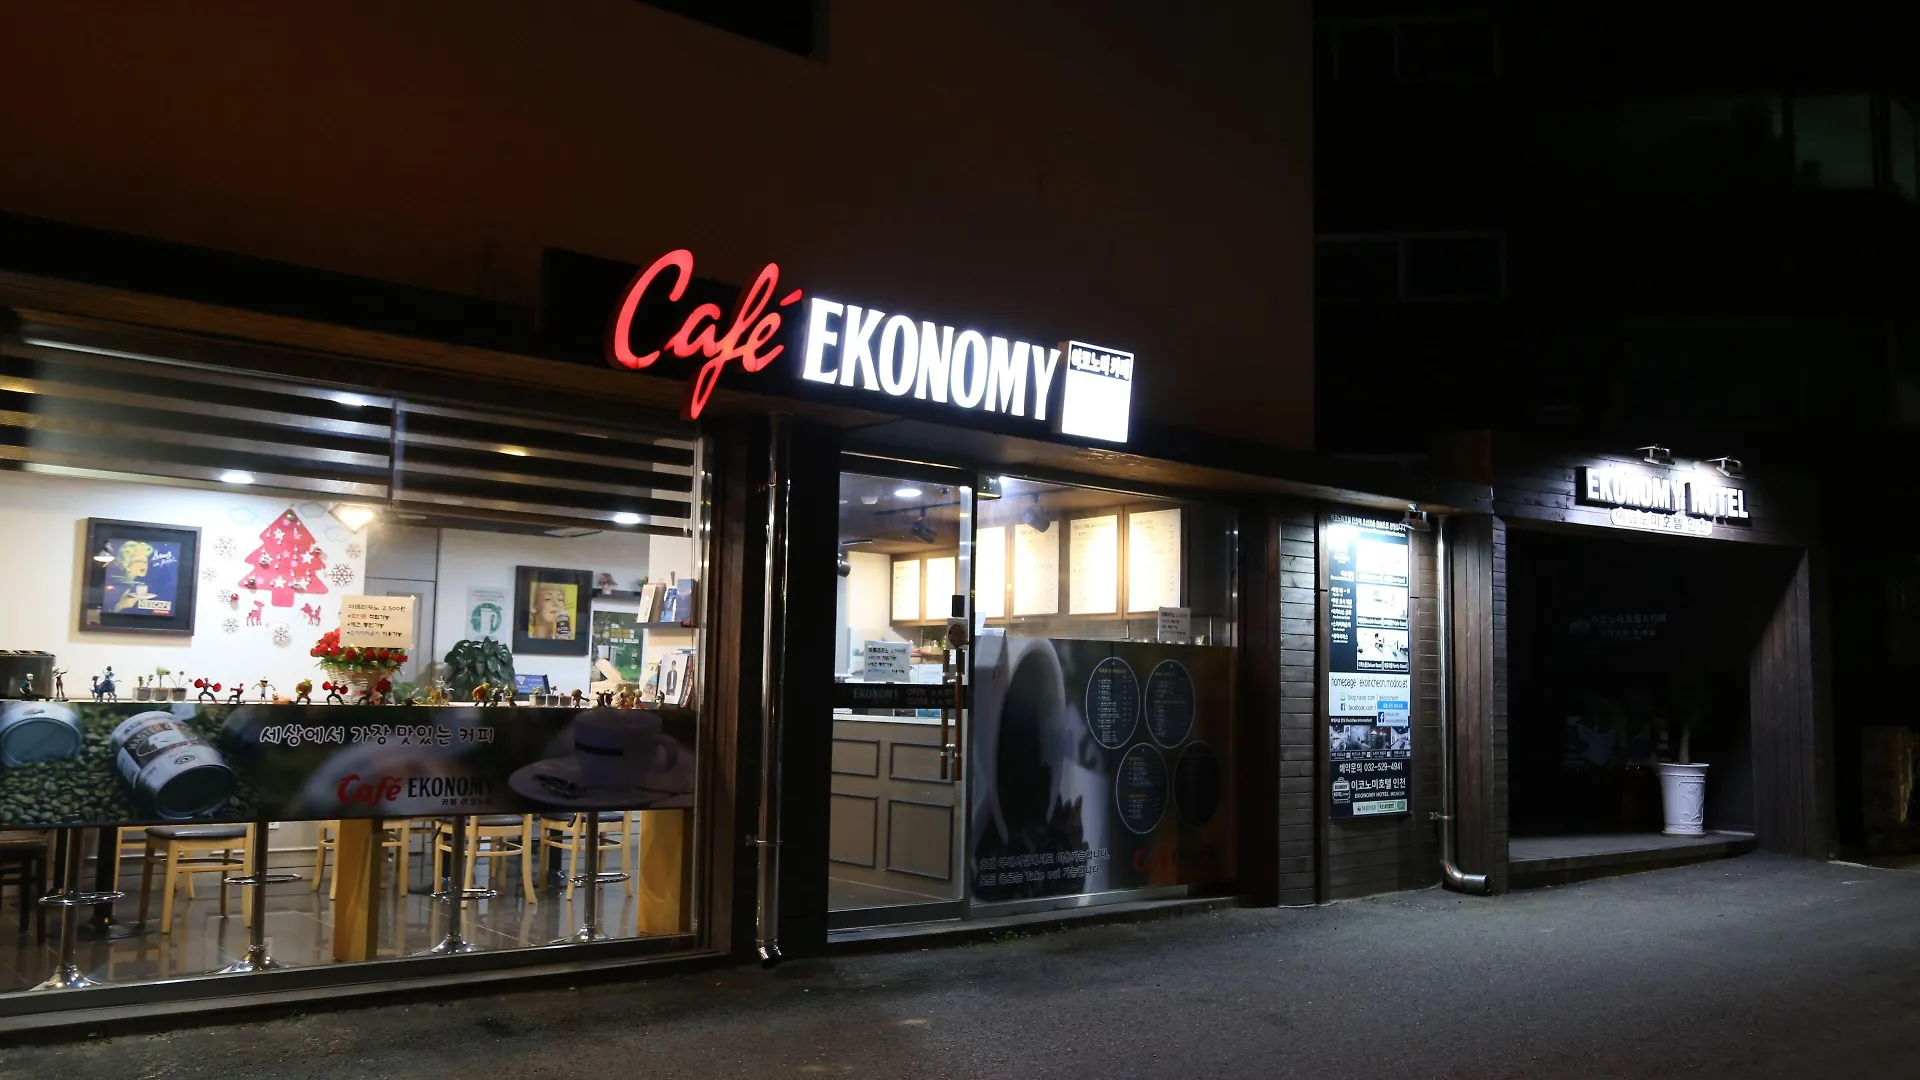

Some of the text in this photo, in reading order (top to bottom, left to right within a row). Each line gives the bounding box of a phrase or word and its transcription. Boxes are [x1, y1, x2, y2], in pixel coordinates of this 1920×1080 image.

[613, 248, 1062, 421] Café EKONOMY
[1587, 467, 1749, 519] EKONOMY HOTEL
[260, 723, 494, 747] 세상에서 가장 맛있는 커피
[1339, 762, 1363, 774] 예약문의
[337, 774, 493, 807] Café EKONOMY
[1351, 777, 1406, 791] 이코노미호텔 인천
